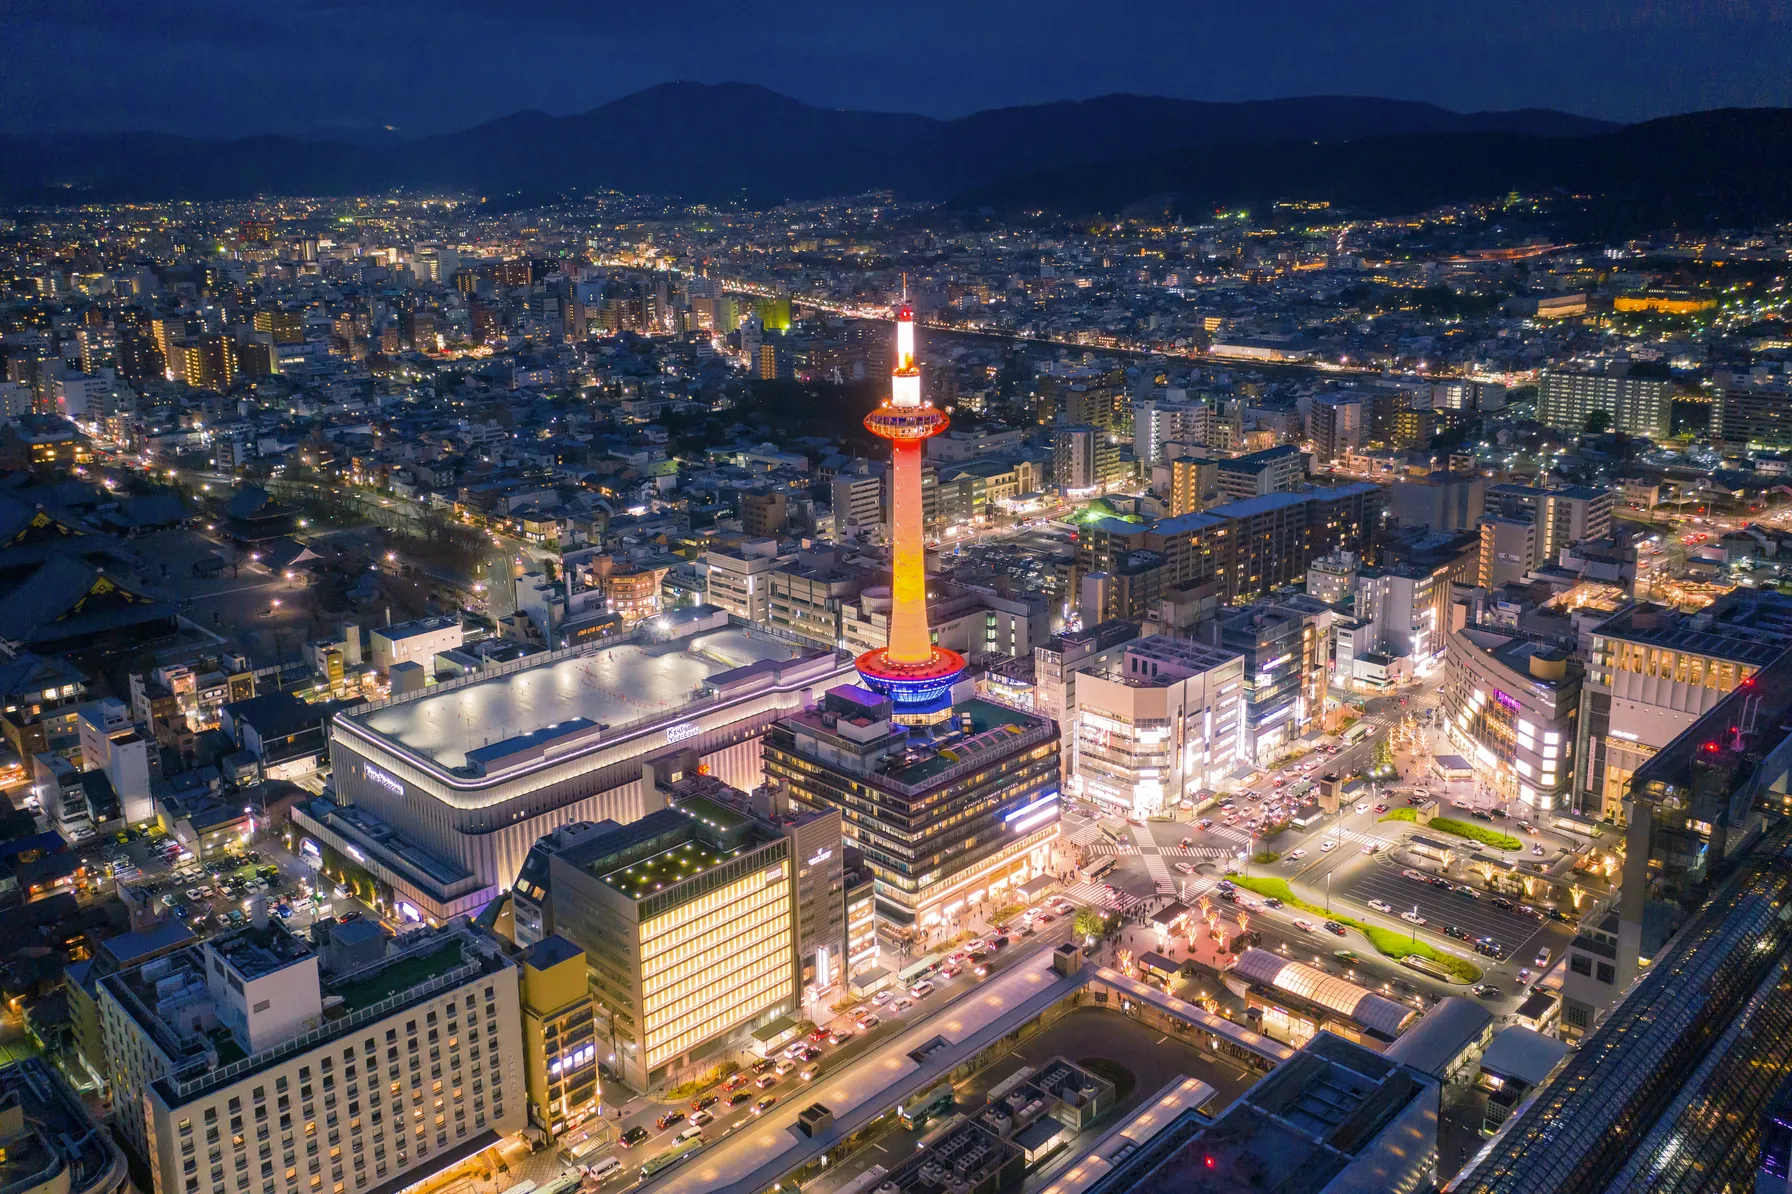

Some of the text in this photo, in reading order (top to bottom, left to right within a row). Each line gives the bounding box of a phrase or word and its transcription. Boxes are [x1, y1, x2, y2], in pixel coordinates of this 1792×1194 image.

[963, 782, 1018, 810] KYOTO TOWER HOTEL
